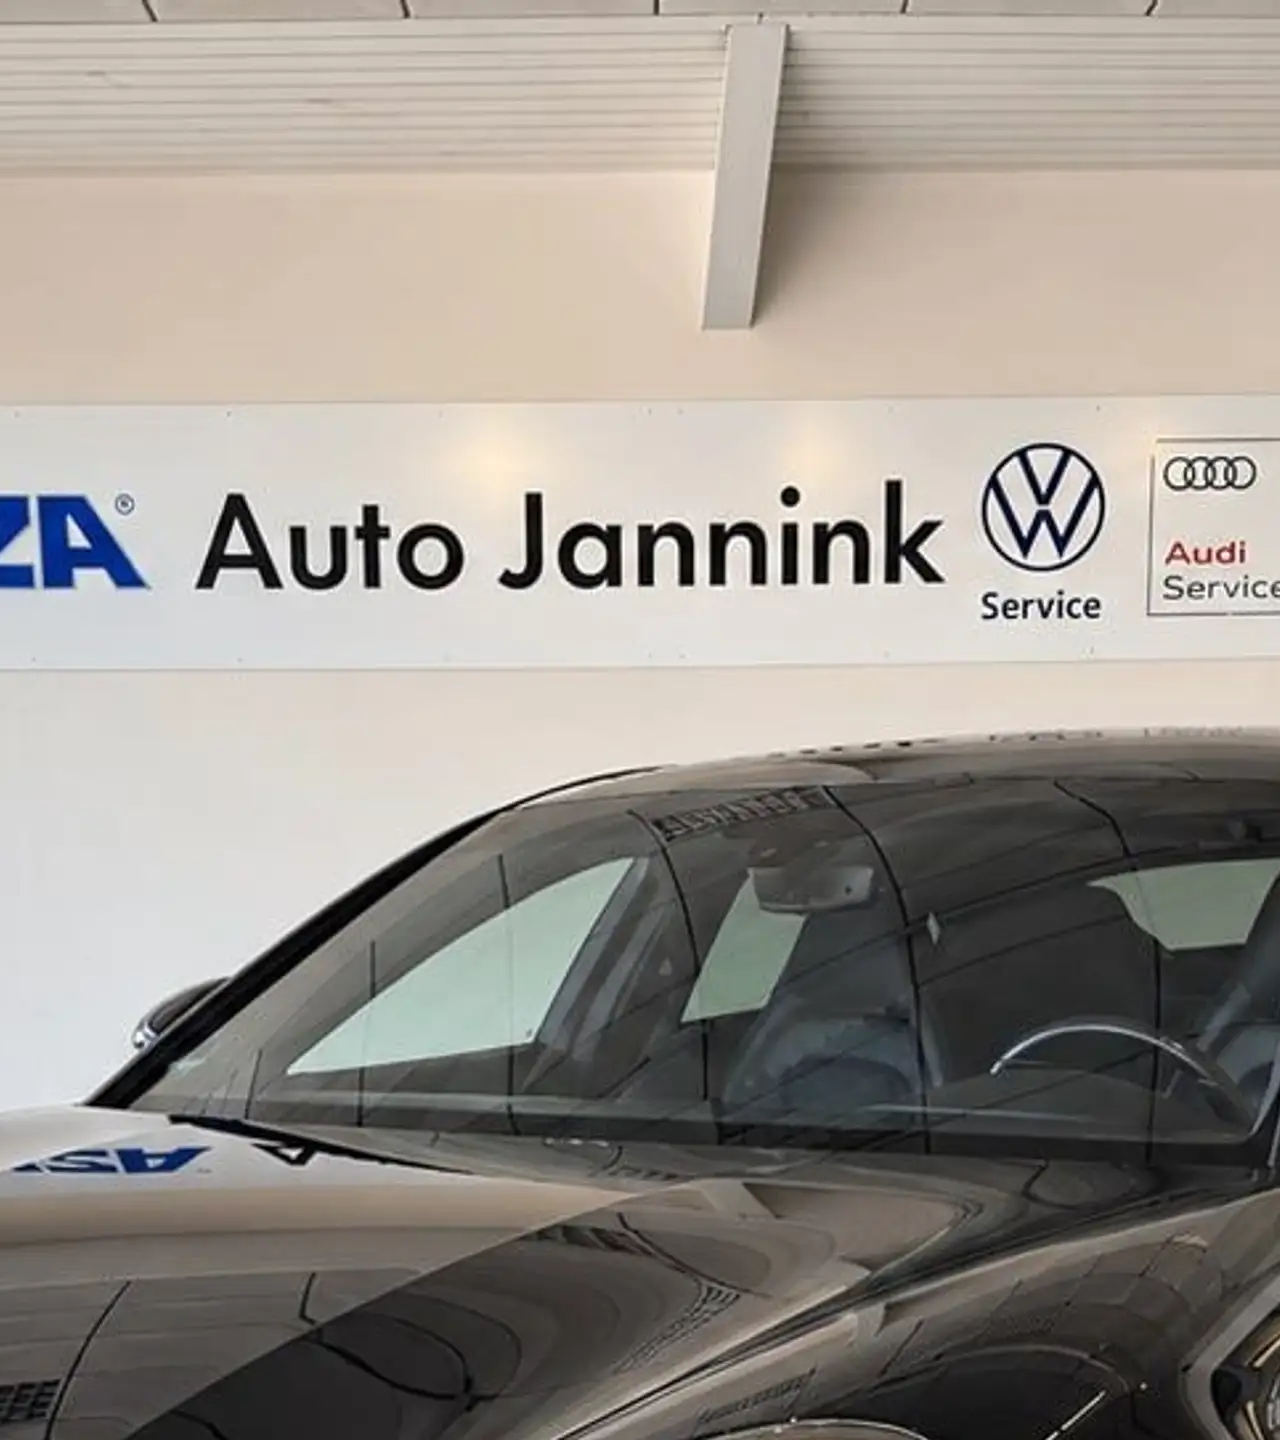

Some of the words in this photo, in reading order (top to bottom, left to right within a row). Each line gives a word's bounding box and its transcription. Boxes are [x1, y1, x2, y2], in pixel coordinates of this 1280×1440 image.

[195, 493, 464, 590] Auto
[498, 479, 945, 590] Jannink
[1164, 541, 1247, 565] Audi
[981, 591, 1102, 621] Service
